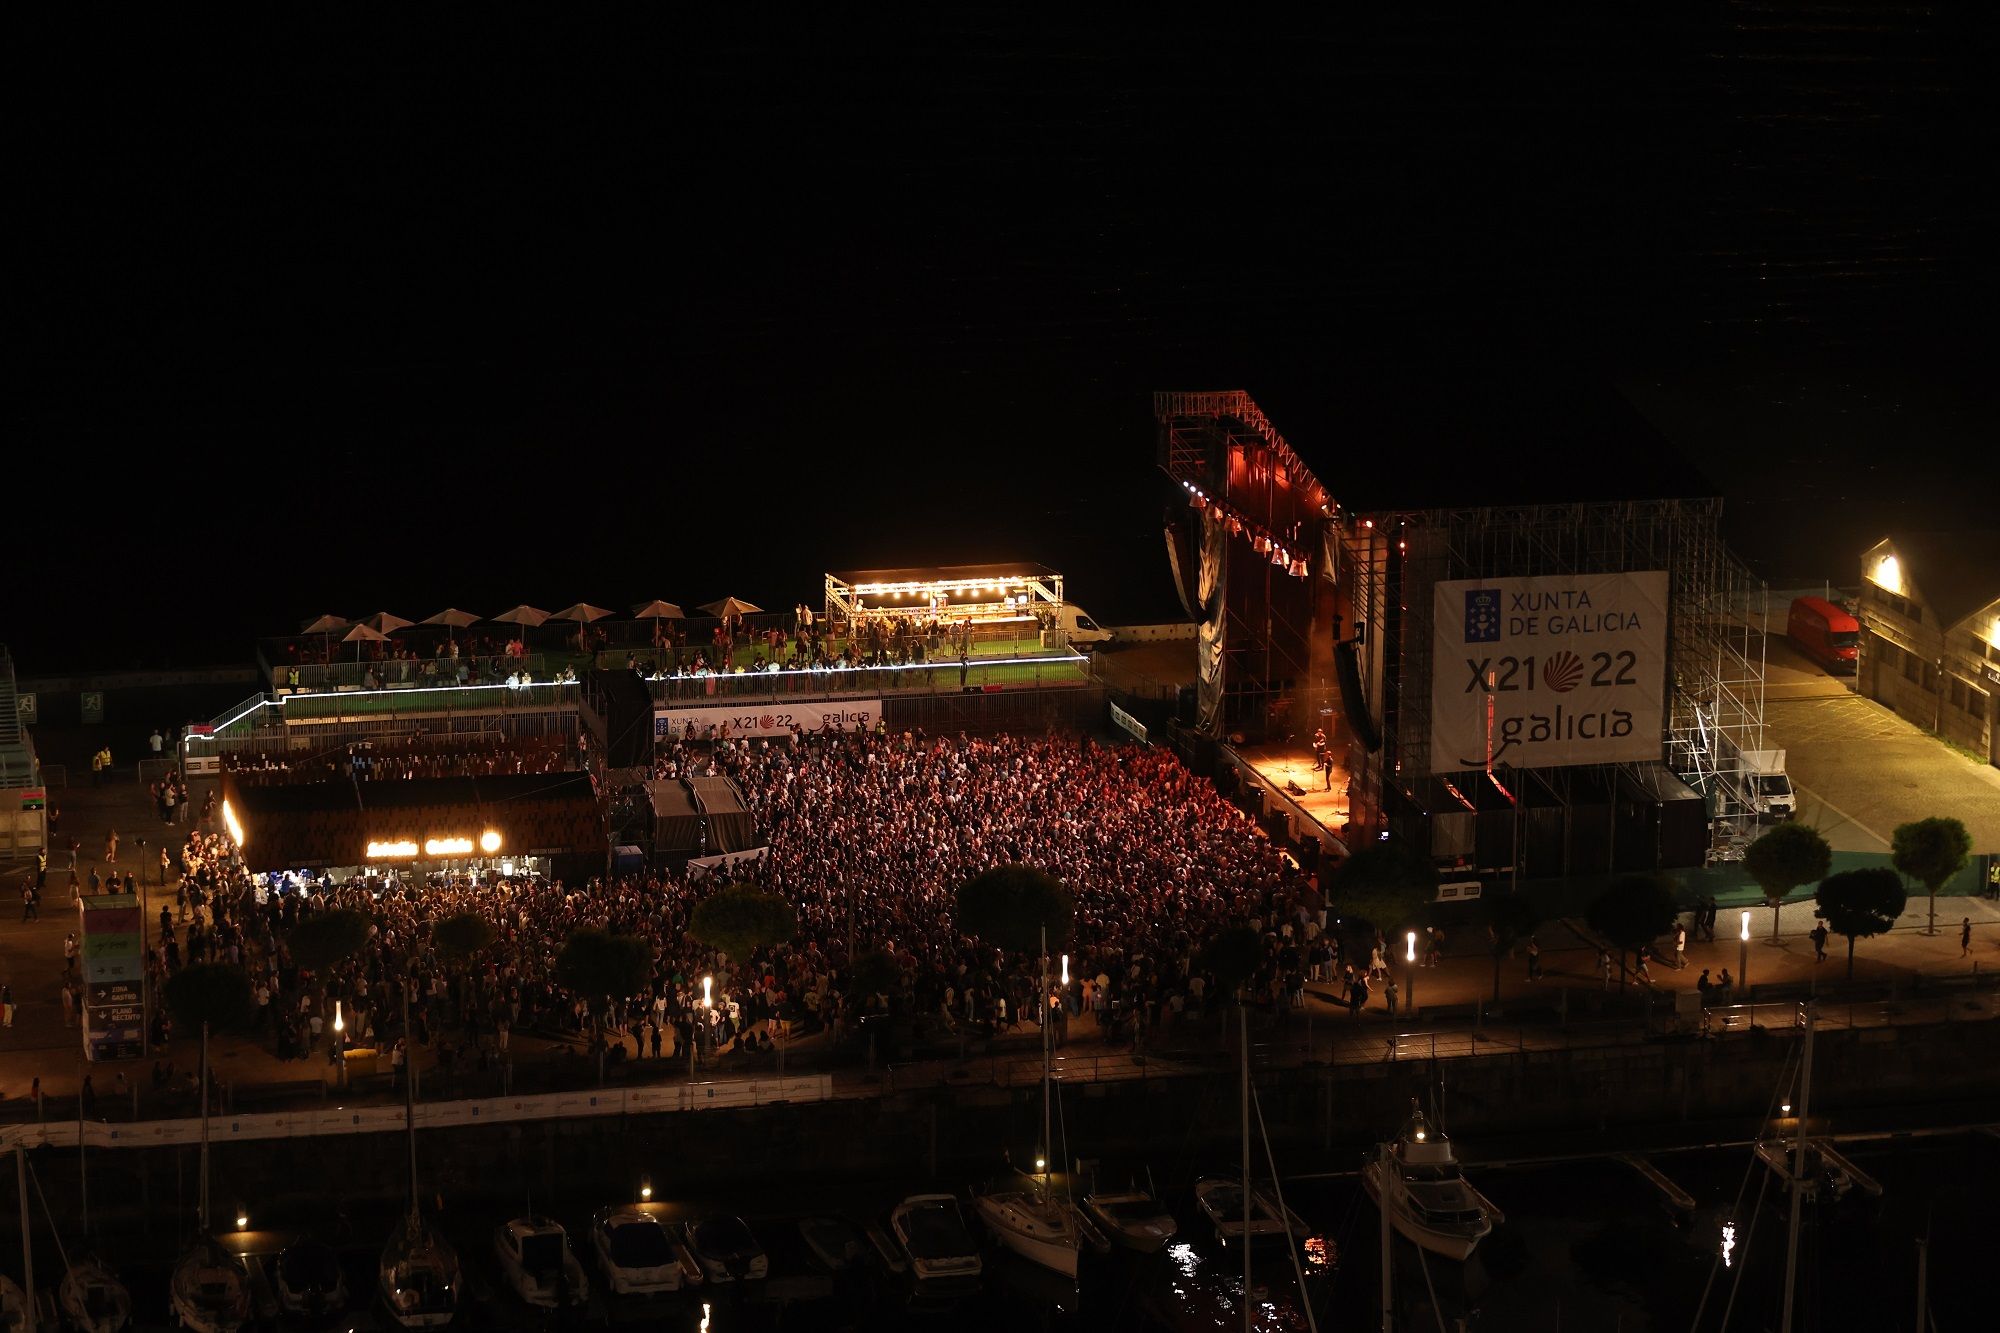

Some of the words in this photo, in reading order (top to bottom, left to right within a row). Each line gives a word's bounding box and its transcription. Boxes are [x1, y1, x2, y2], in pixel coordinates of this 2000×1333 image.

[1511, 590, 1592, 611] XUNTA
[1510, 616, 1539, 636] DE
[1547, 612, 1641, 634] GALICIA
[1590, 650, 1636, 687] 22
[671, 717, 700, 725] XUNTA
[776, 714, 792, 727] 22
[1460, 705, 1633, 767] galicia
